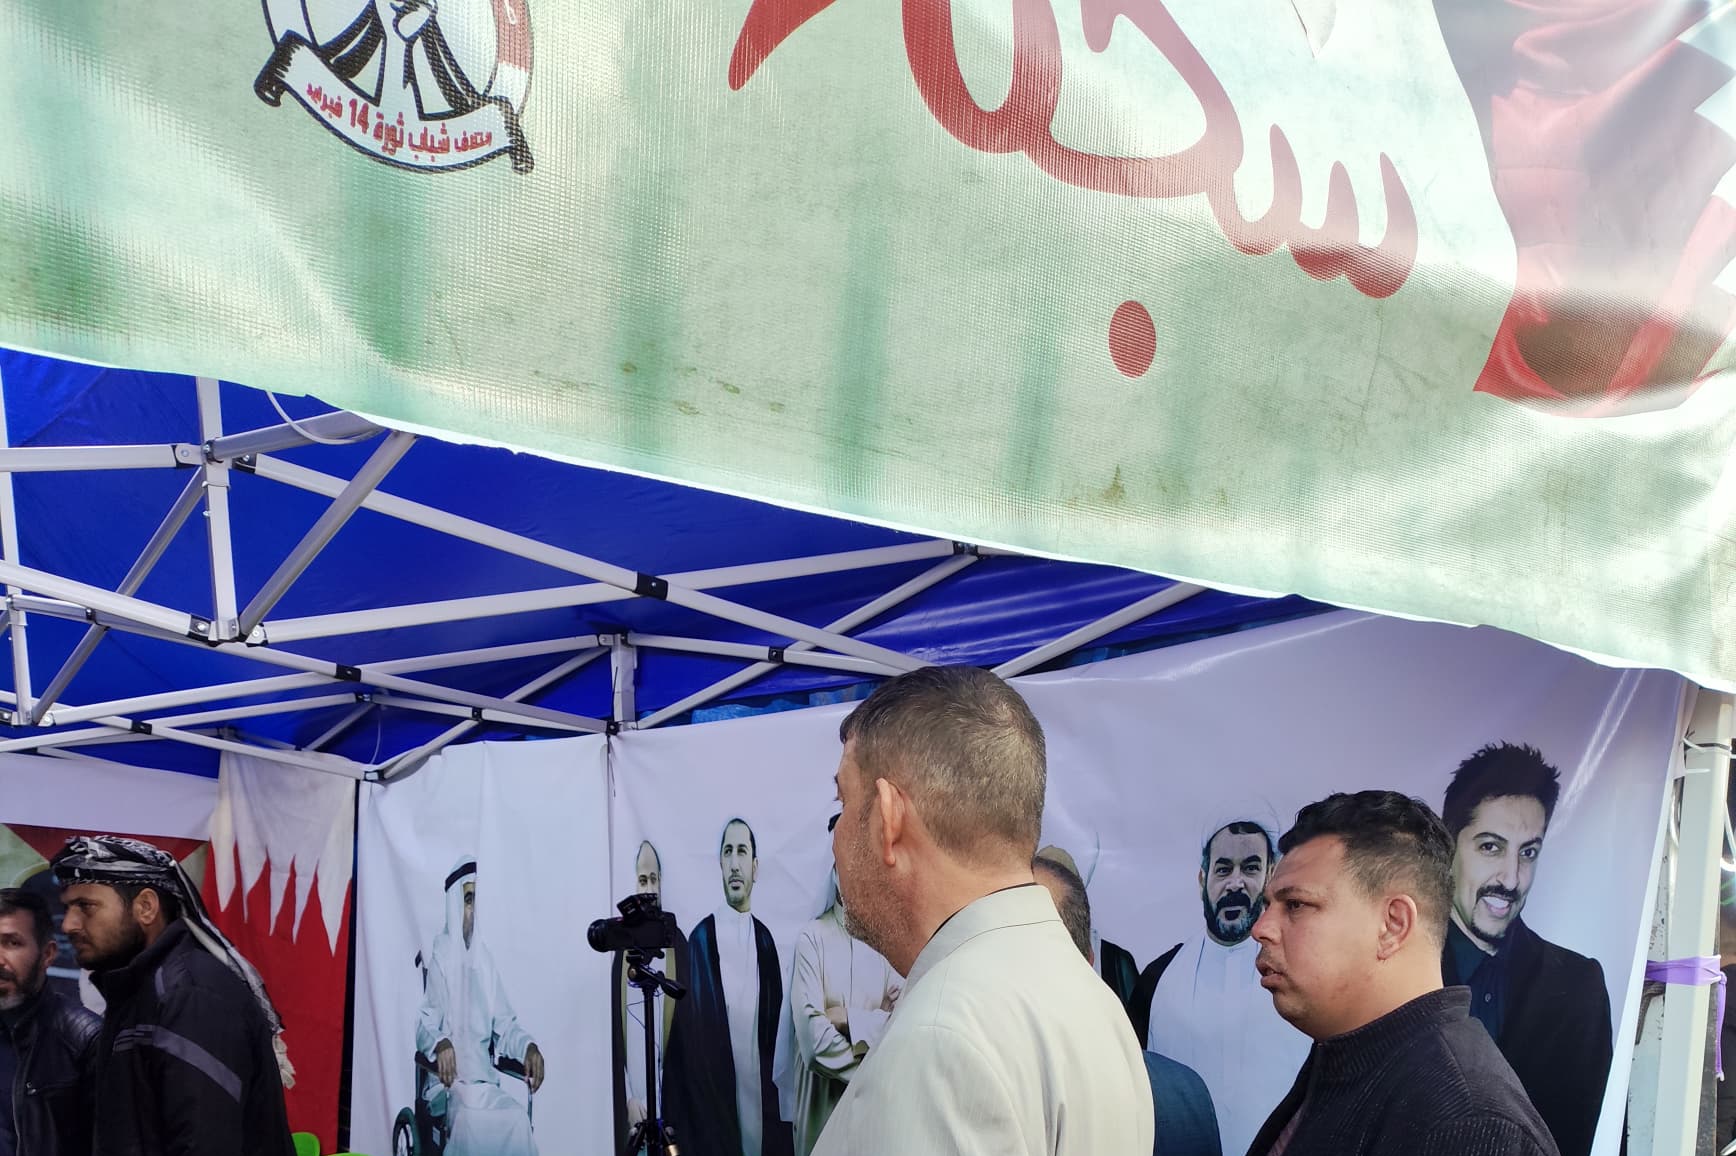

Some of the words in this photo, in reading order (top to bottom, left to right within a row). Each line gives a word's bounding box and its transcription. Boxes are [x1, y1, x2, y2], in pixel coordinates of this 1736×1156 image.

[348, 97, 370, 134] 14
[372, 111, 405, 156] ثورة
[408, 122, 451, 162] شباب
